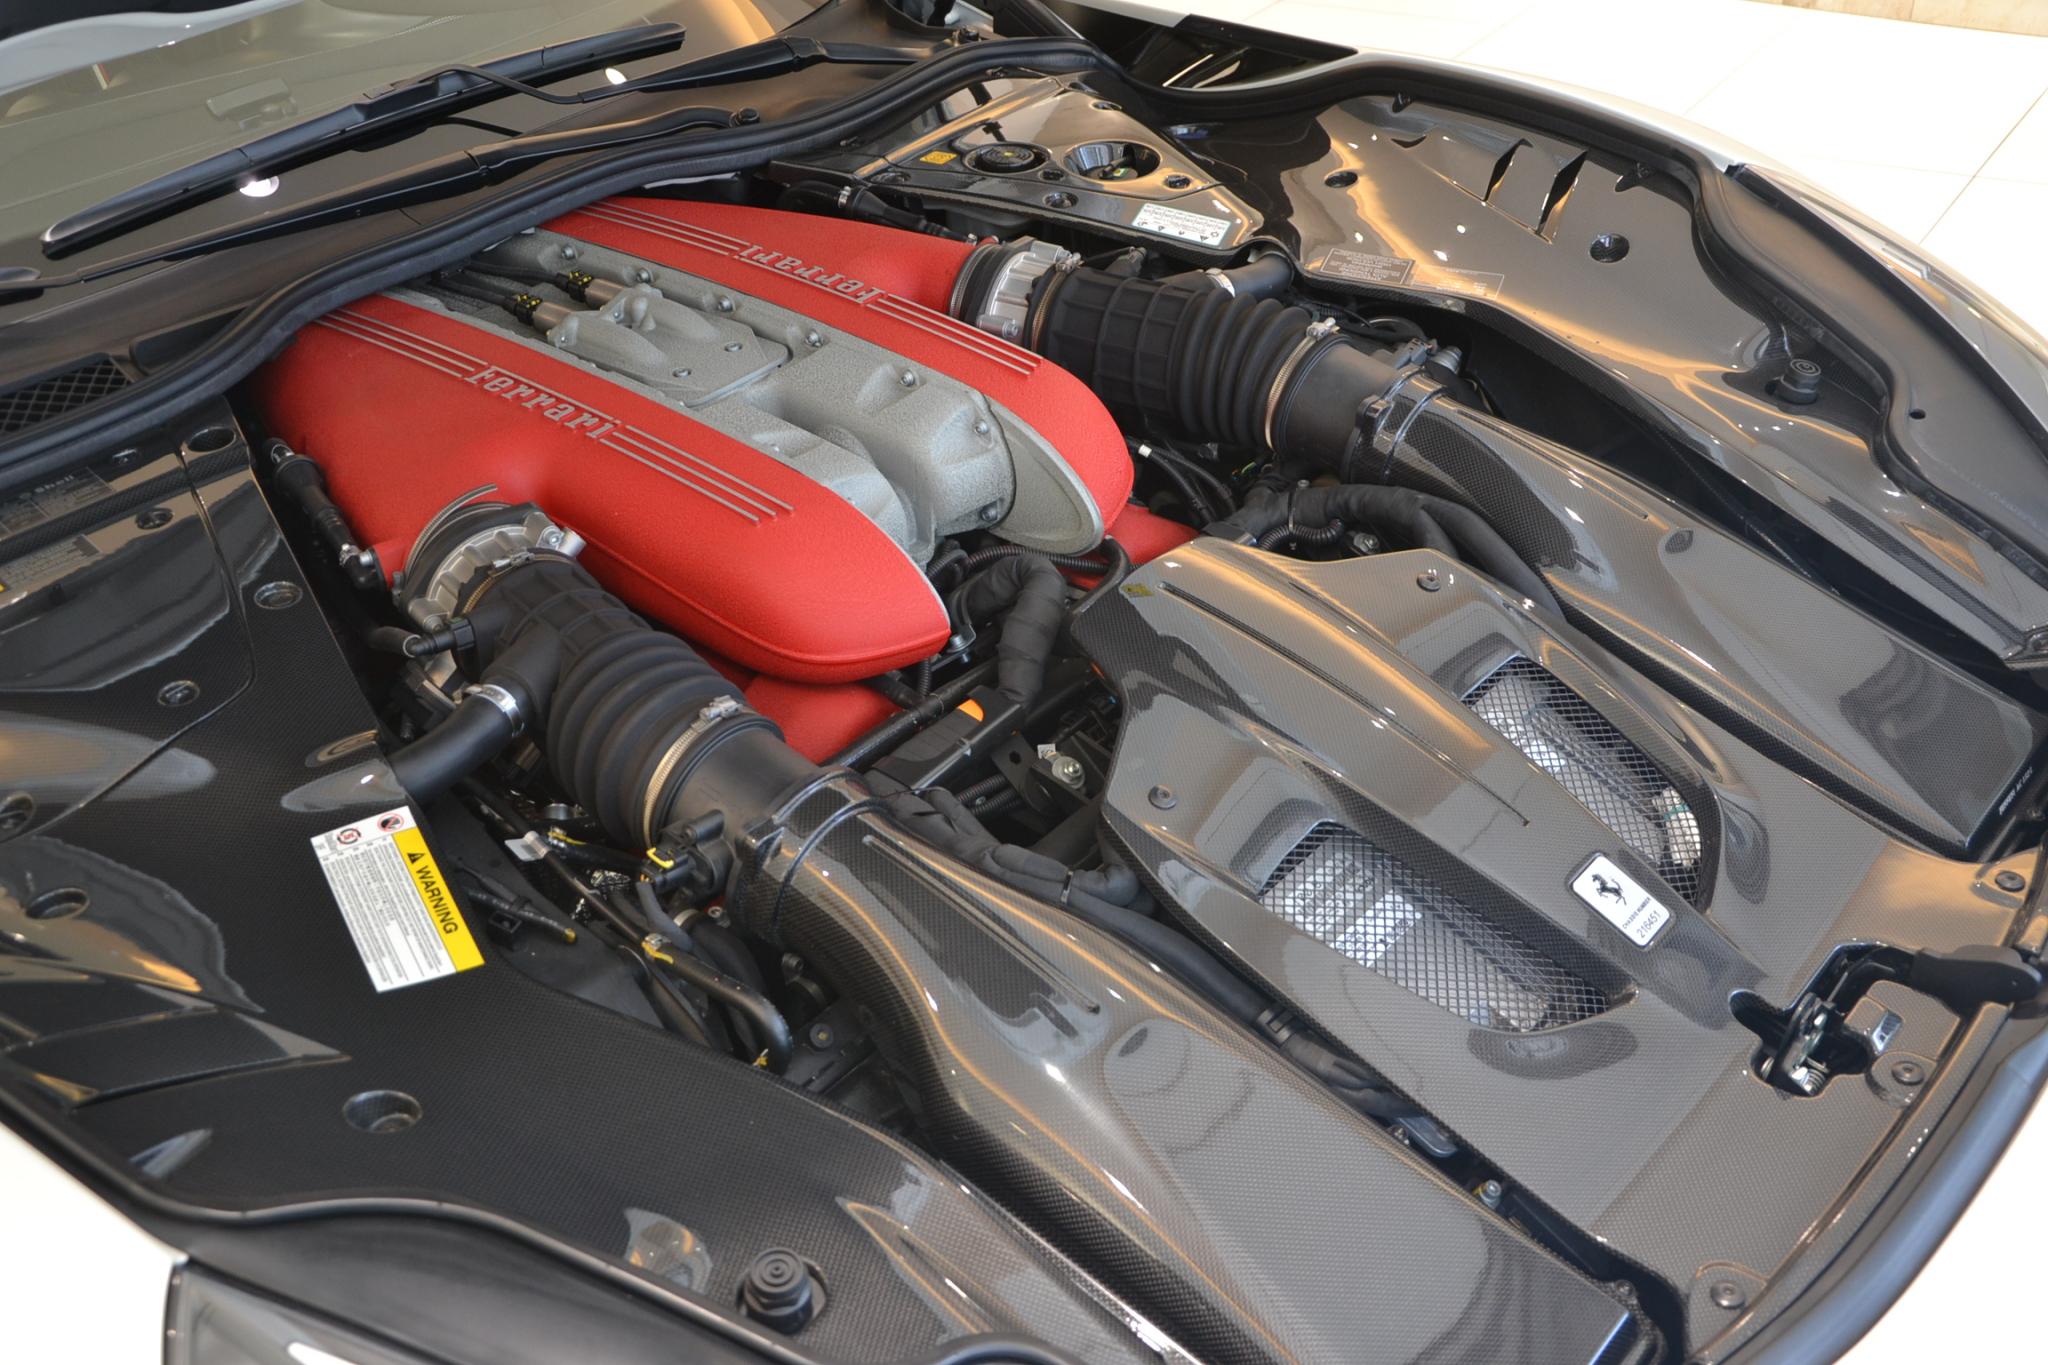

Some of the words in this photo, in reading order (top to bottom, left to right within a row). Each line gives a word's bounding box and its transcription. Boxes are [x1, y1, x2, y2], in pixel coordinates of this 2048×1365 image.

[734, 245, 886, 304] Ferrari
[464, 366, 621, 439] Ferrari
[34, 474, 75, 493] Shell
[416, 865, 458, 934] WARNING
[1638, 910, 1661, 938] 216451
